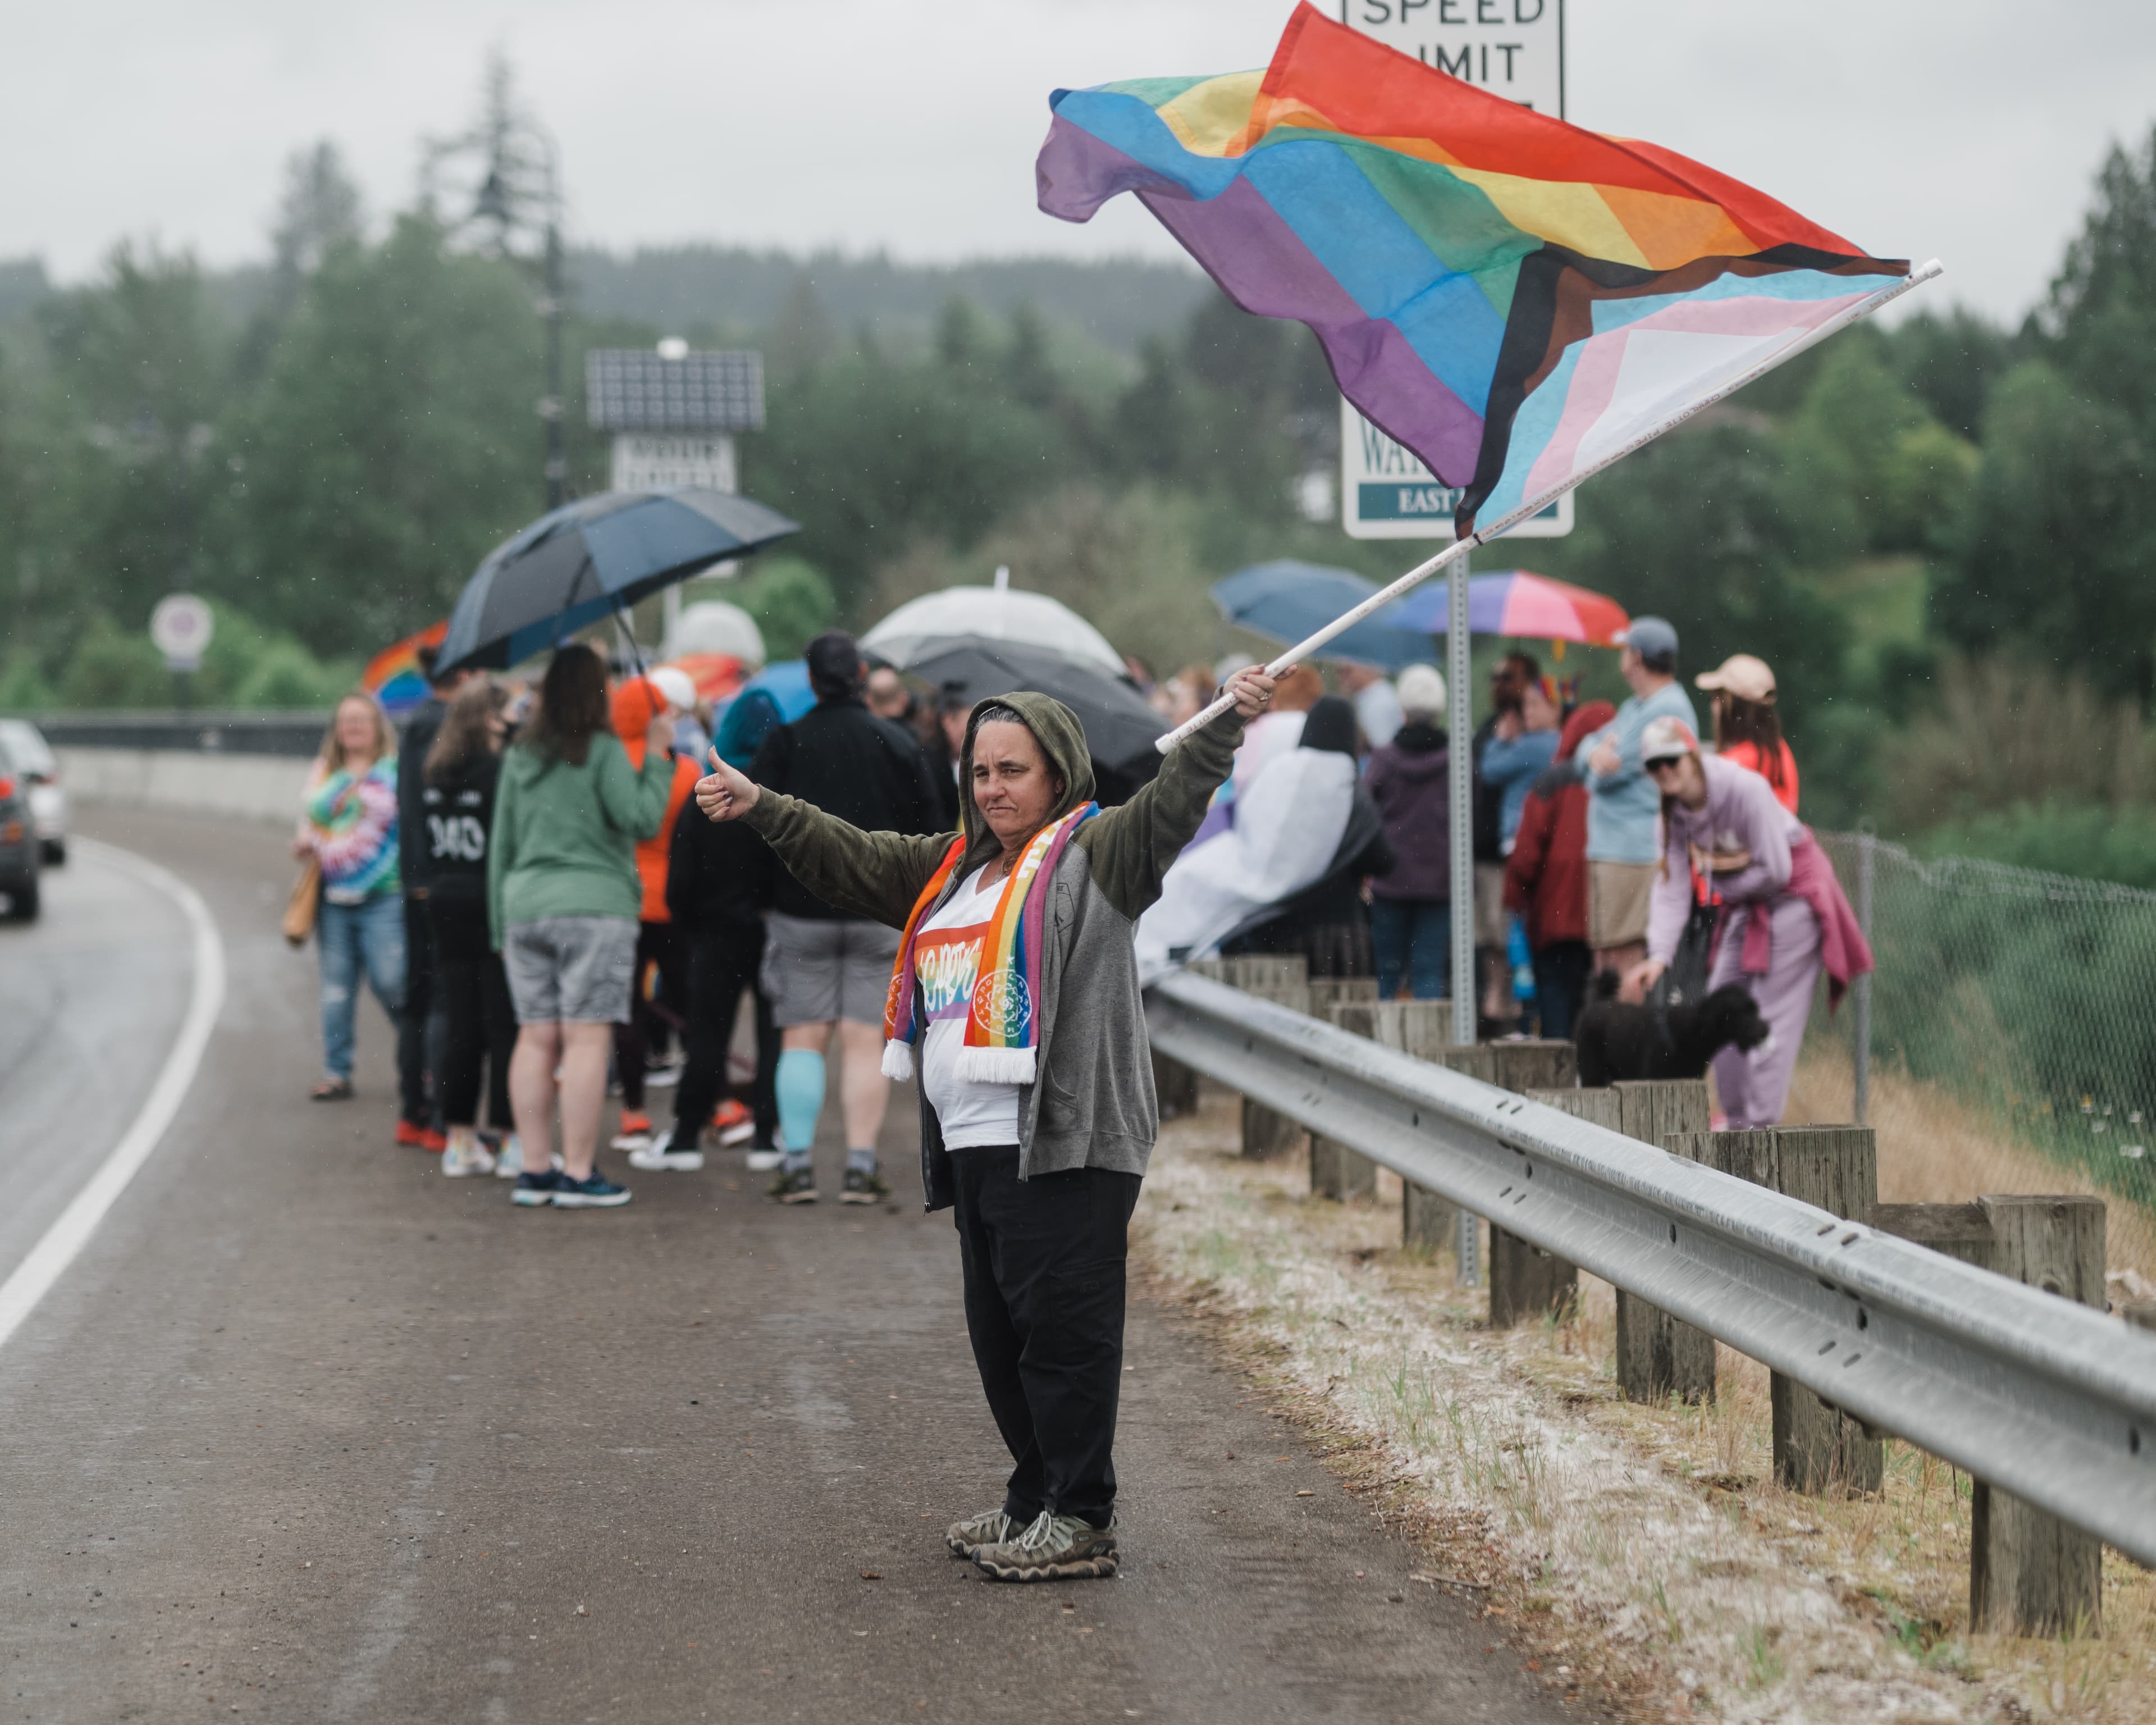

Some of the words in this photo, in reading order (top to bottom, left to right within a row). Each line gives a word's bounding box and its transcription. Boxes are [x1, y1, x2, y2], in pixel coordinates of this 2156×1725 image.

[1363, 0, 1544, 24] SPEED
[1420, 43, 1523, 83] IMIT
[1634, 428, 1660, 446] PIPE
[1397, 486, 1455, 514] EAST
